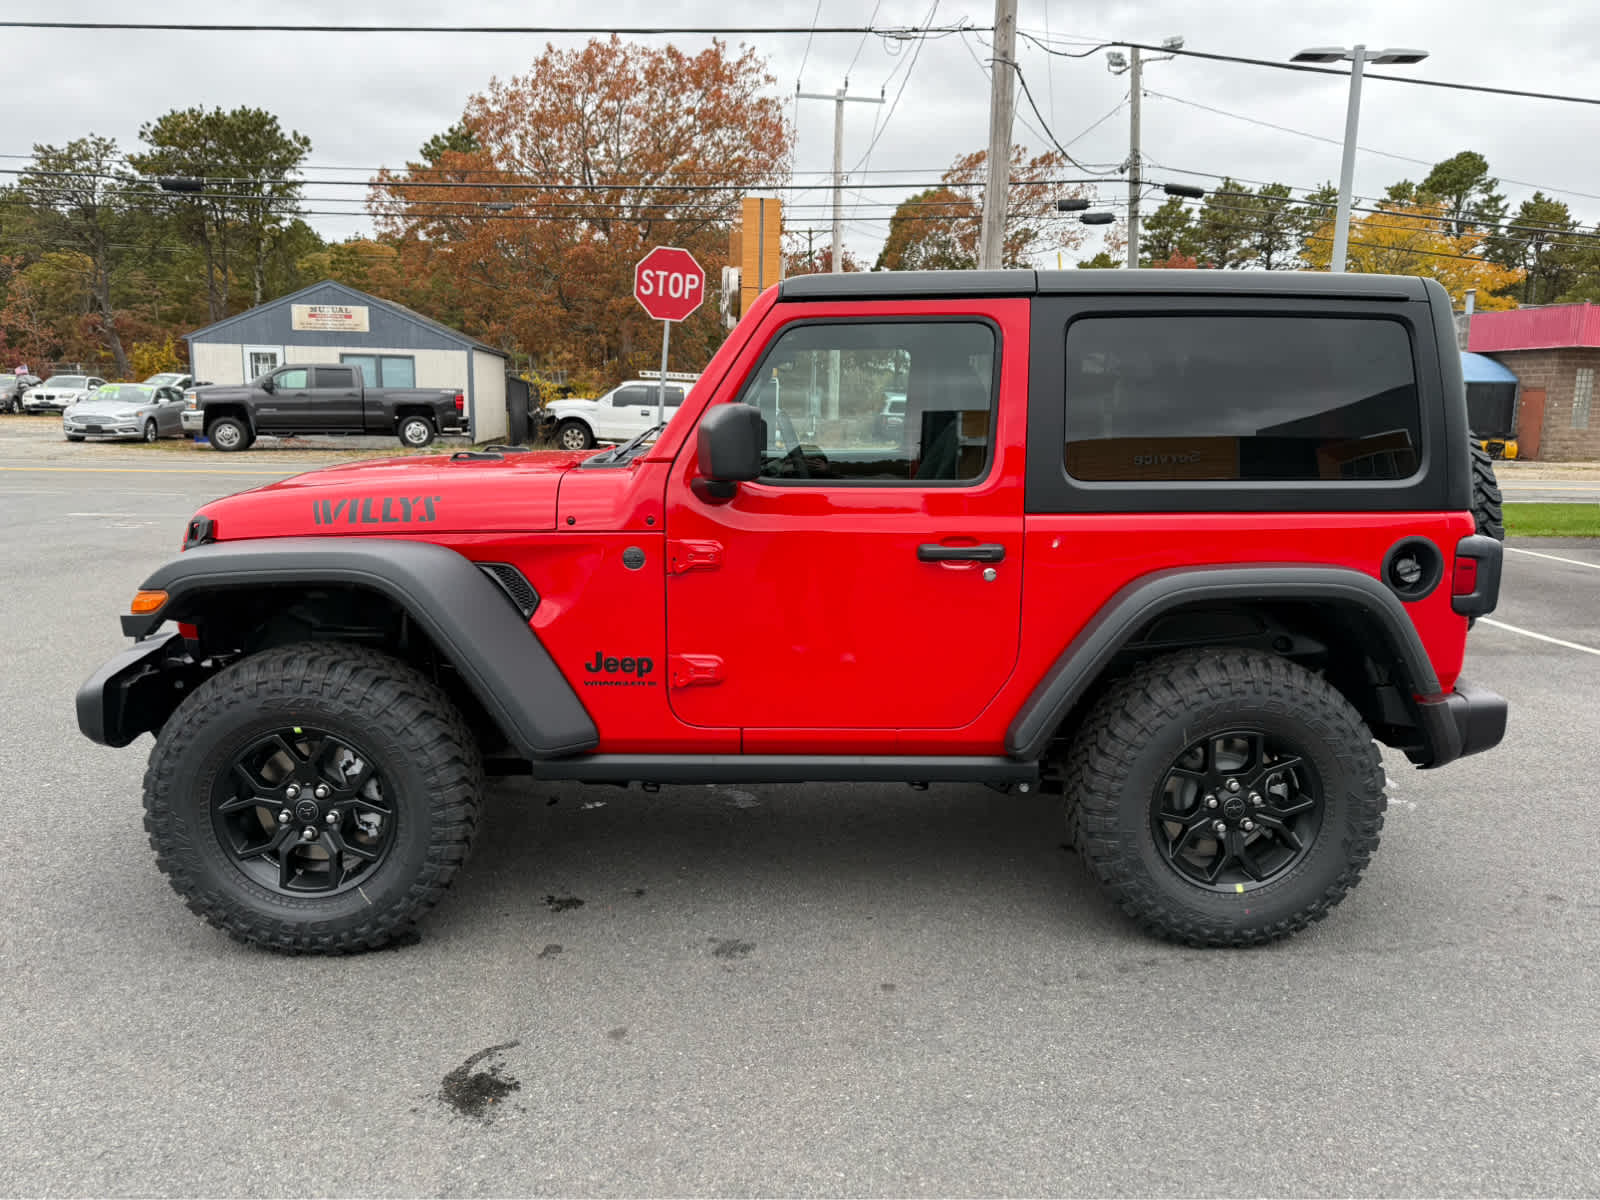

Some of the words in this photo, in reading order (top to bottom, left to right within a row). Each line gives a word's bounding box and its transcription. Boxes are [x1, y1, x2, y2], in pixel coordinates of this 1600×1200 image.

[640, 269, 700, 300] STOP
[313, 496, 441, 524] WILLYS
[584, 651, 654, 678] Jeep
